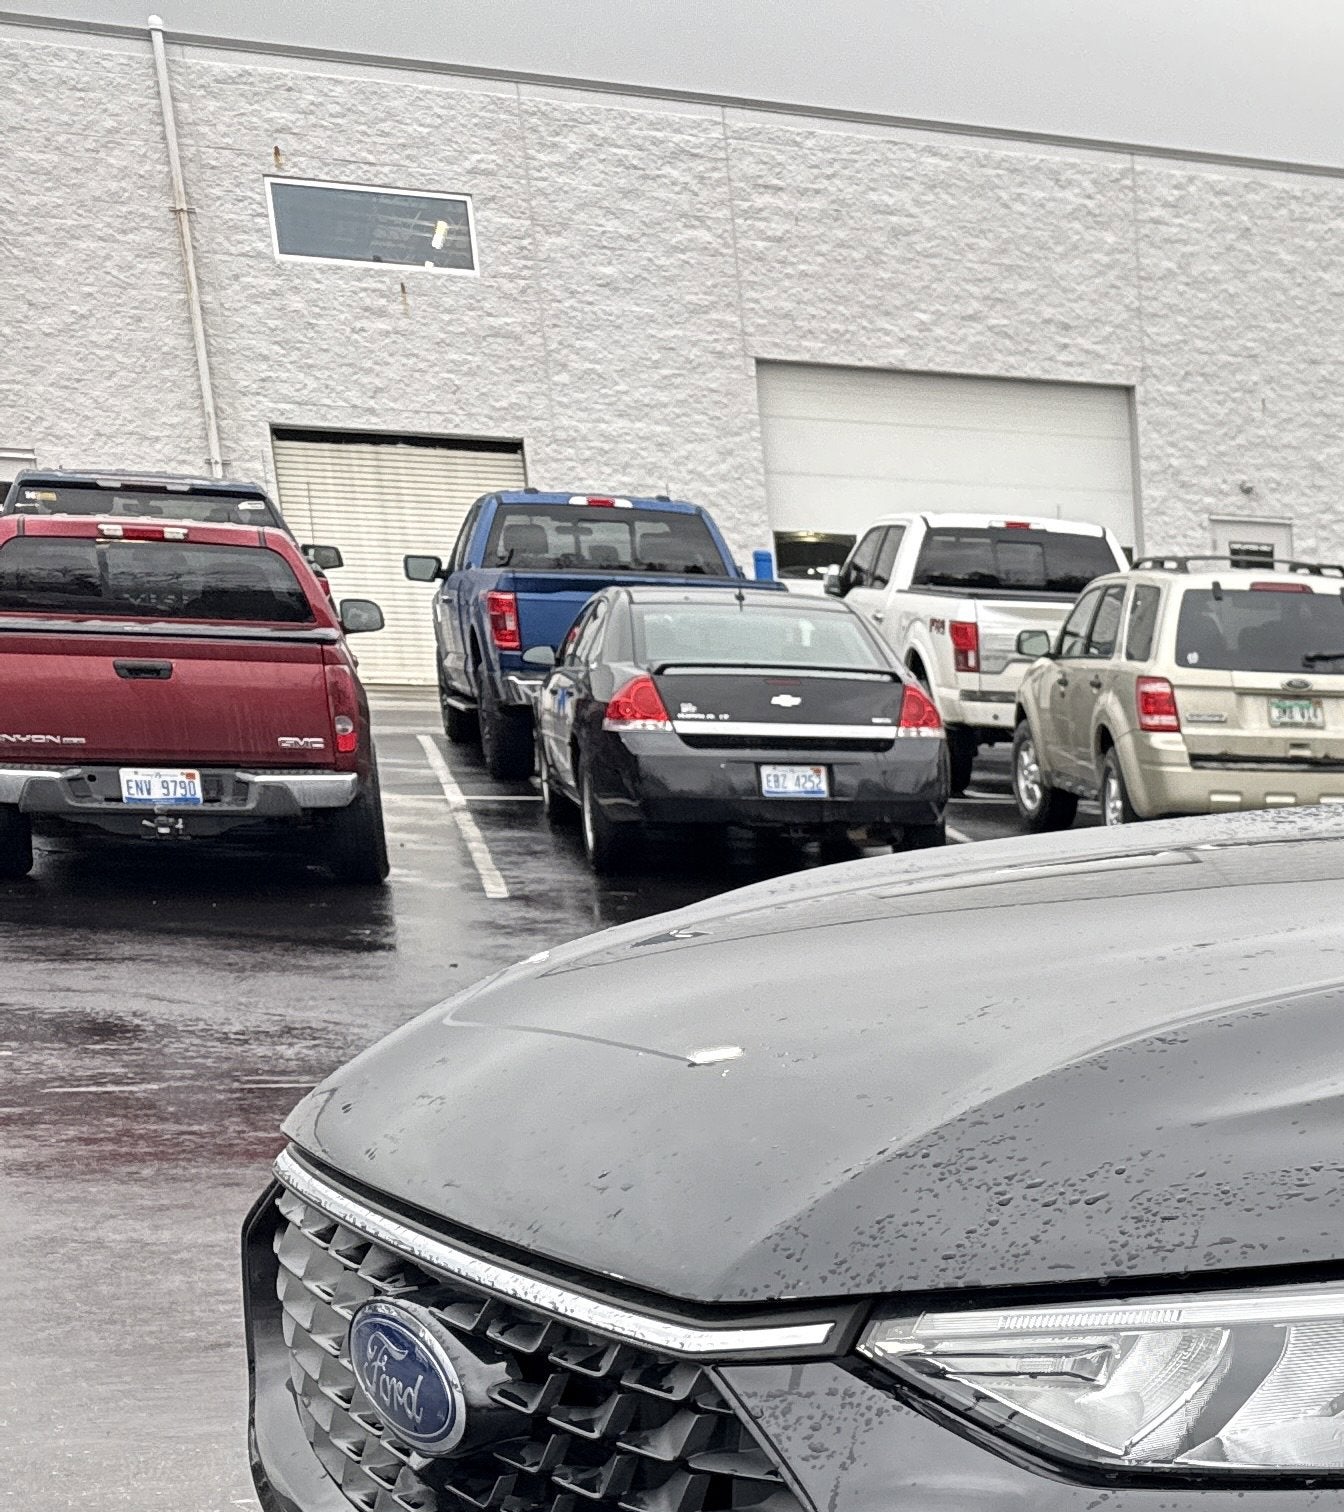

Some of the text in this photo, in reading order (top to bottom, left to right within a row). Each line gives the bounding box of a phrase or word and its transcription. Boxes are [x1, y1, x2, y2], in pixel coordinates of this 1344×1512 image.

[277, 736, 325, 750] GMC
[126, 779, 198, 798] ENV 9790
[363, 1330, 424, 1425] Ford
